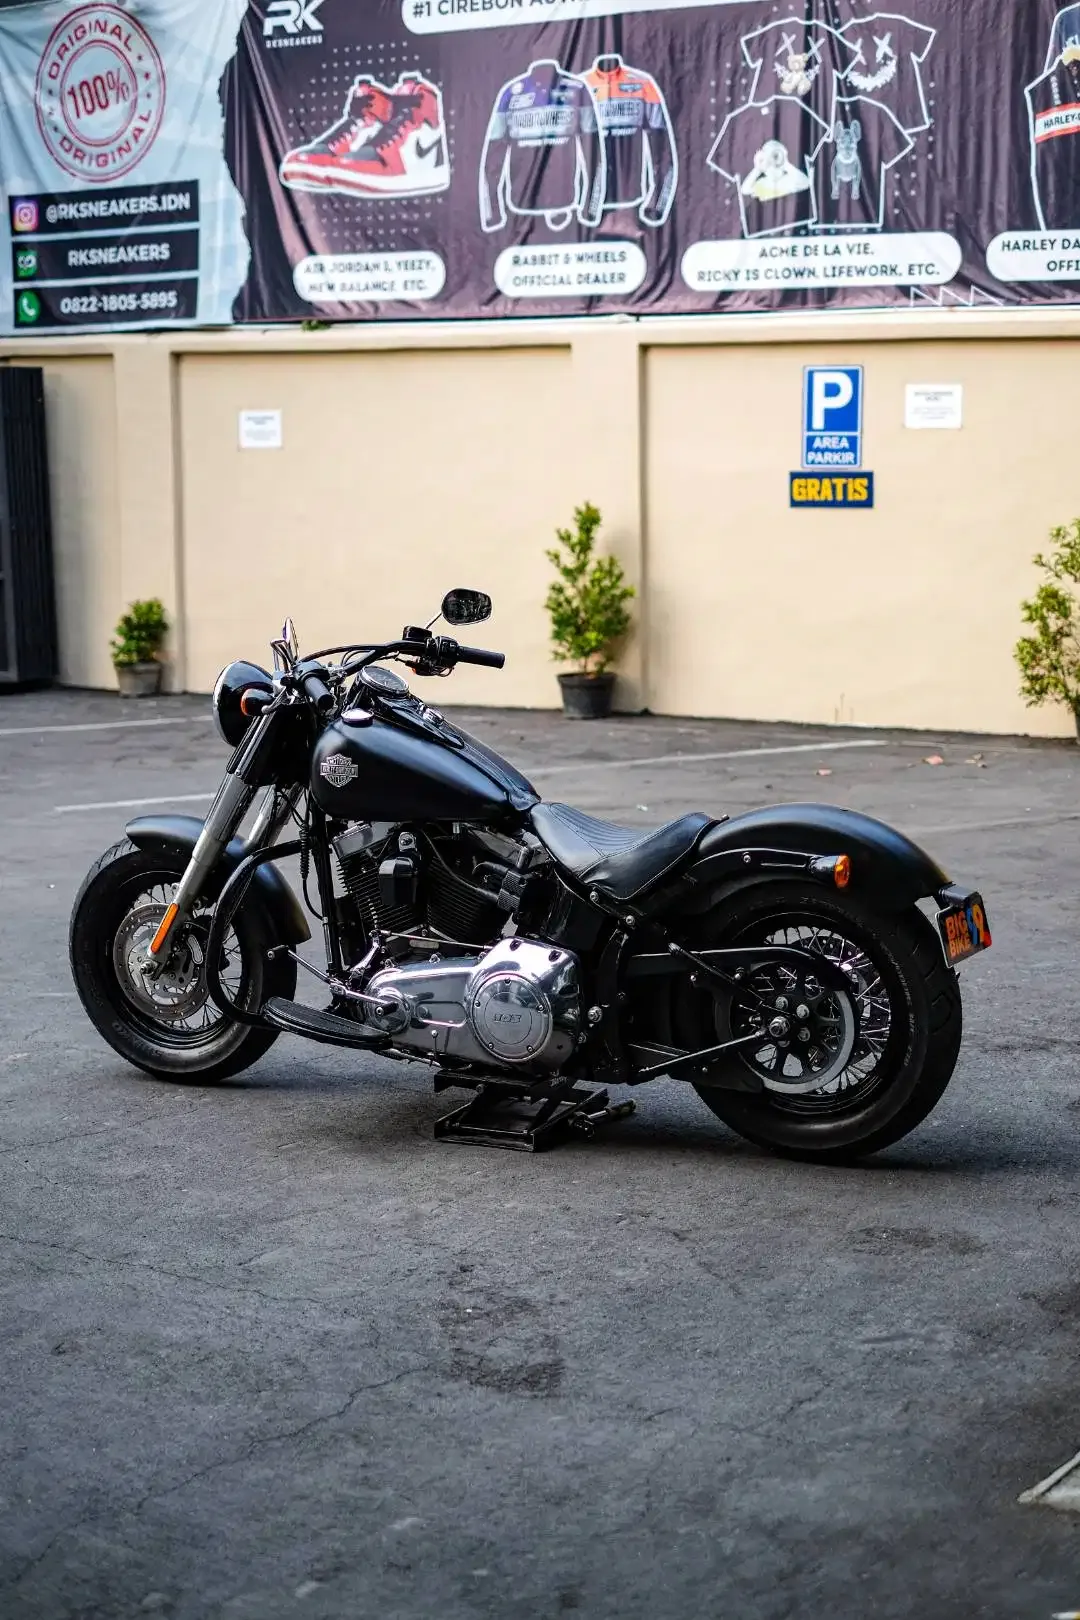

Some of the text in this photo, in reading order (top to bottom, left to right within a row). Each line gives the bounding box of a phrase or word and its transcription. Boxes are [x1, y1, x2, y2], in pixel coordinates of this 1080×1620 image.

[263, 0, 324, 36] RK
[412, 3, 432, 18] #1
[437, 0, 522, 15] CIREBON
[48, 19, 133, 80] ORIGINAL
[67, 68, 130, 119] 100%
[59, 110, 152, 168] ORIGINAL
[46, 193, 190, 223] @RKSNEAKERS.IDN
[68, 243, 170, 266] RKSNEAKERS
[758, 245, 798, 258] ACHE
[803, 244, 820, 257] DE
[823, 243, 842, 256] LA
[1002, 239, 1057, 252] HARLEY
[512, 254, 559, 266] RABBIT
[575, 251, 627, 263] WHEELS
[512, 272, 626, 287] OFFICIAL DEALER
[697, 268, 740, 282] RICKY
[745, 268, 760, 280] IS
[908, 263, 940, 276] ETC.
[60, 290, 177, 314] 0822-1805-5895
[812, 371, 853, 430] P
[812, 437, 849, 449] AREA
[807, 451, 855, 465] PARKIR
[792, 478, 869, 501] GRATIS
[946, 911, 968, 938] BIG
